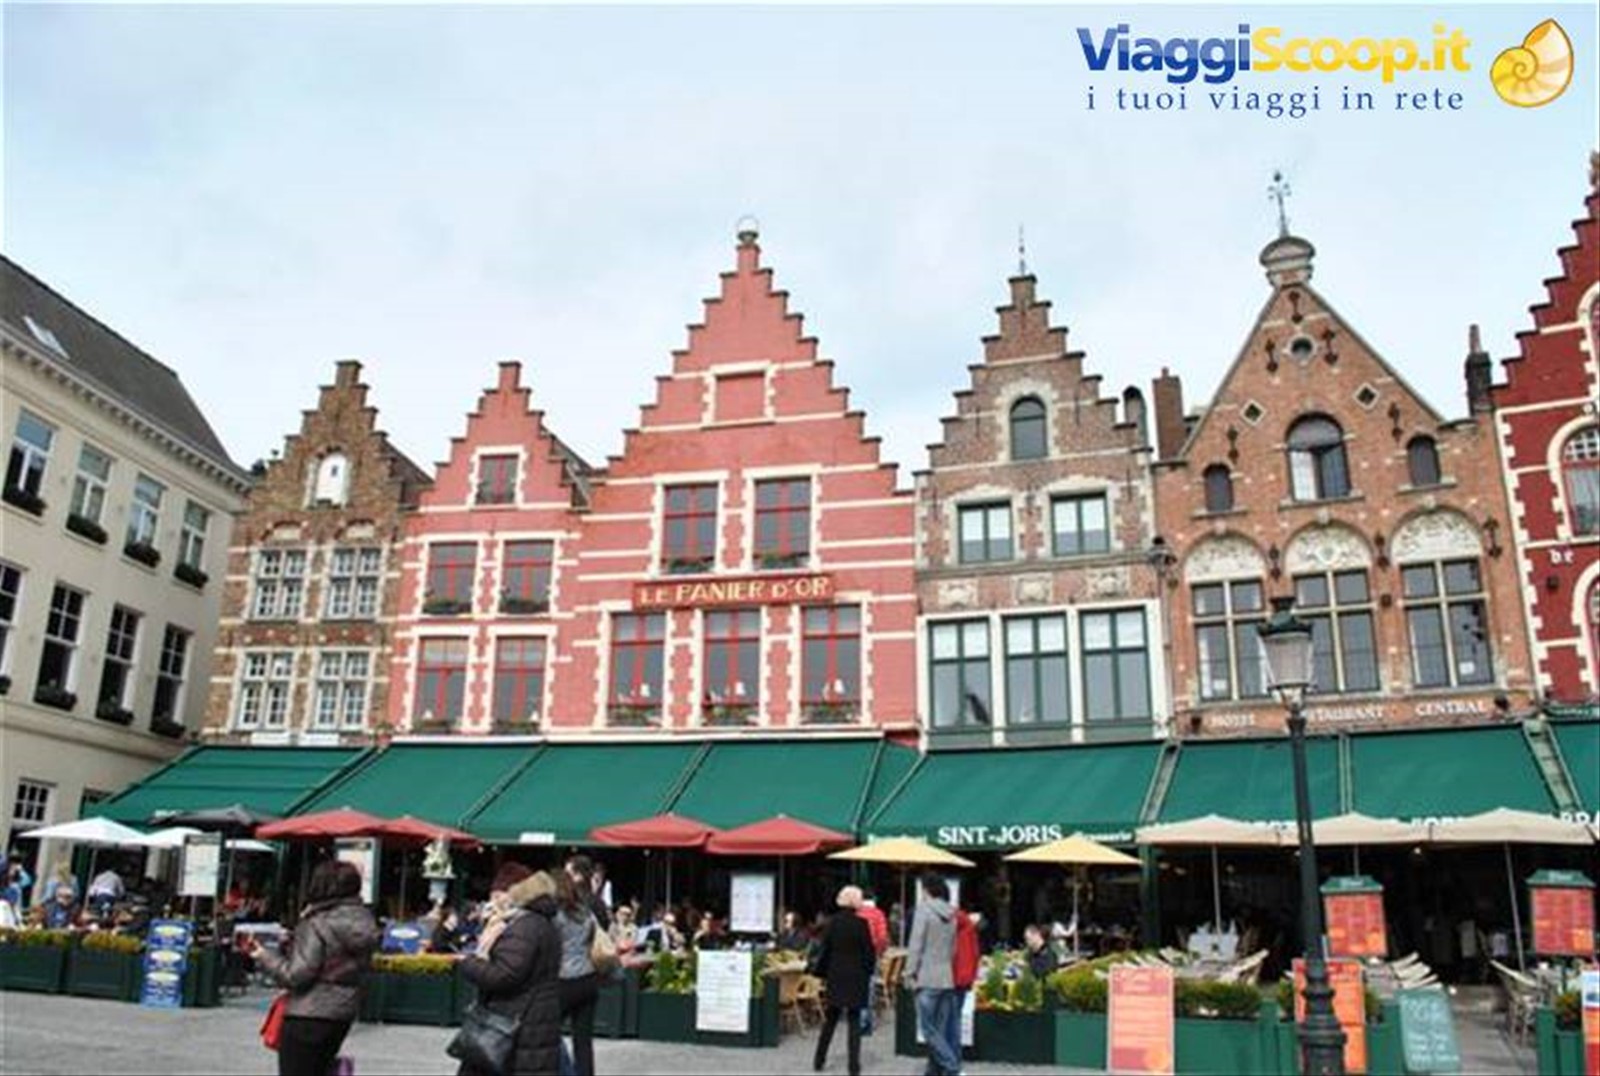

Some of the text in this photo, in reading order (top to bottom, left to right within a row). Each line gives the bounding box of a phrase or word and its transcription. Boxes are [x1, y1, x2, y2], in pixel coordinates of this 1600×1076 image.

[640, 587, 668, 604] LE
[675, 580, 766, 601] PANIER
[1415, 699, 1489, 716] CENTRAL
[937, 824, 1063, 846] SINT-JORIS
